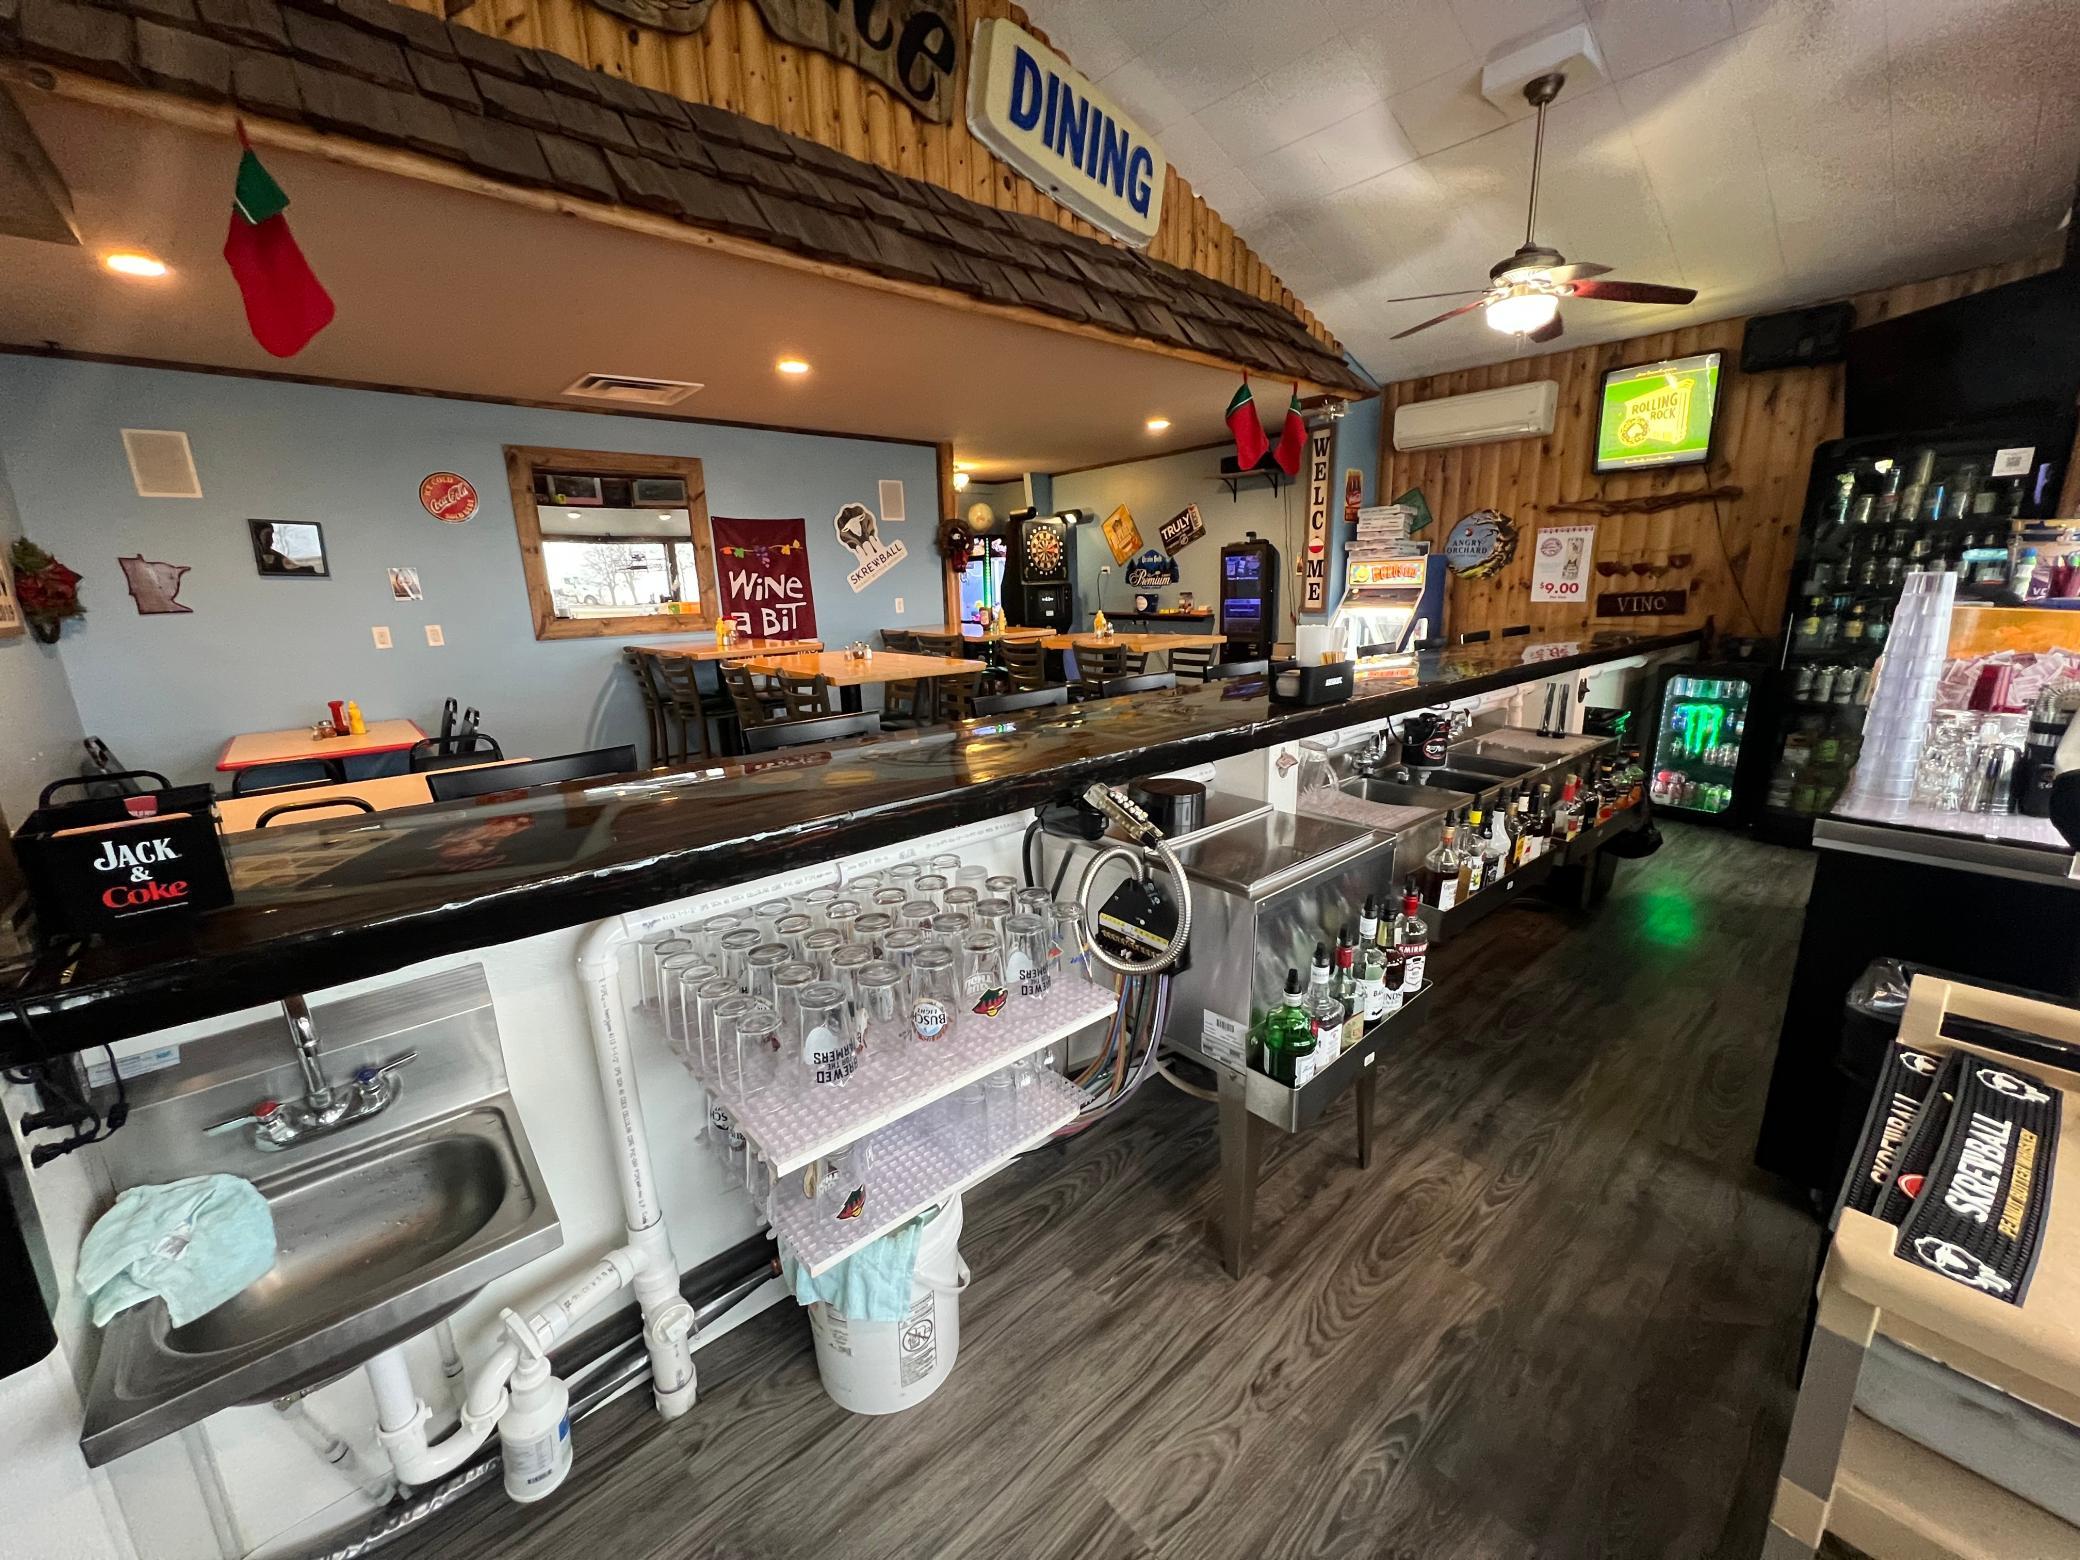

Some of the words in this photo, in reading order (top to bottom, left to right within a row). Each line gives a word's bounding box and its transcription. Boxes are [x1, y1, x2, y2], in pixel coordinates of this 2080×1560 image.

[1008, 46, 1153, 218] DINING
[1631, 392, 1678, 414] ROLLING
[1650, 407, 1676, 420] ROCK
[1160, 513, 1191, 540] TRULY
[1446, 546, 1488, 554] ORCHARD
[1452, 539, 1483, 547] ANGRY
[850, 543, 903, 586] SKREWBALL
[1128, 568, 1171, 588] Premium
[1540, 582, 1579, 594] $9.00
[94, 837, 178, 871] JACK
[130, 866, 153, 883] &
[102, 880, 189, 908] Coke
[1945, 1112, 2013, 1224] SKREWBALL
[2006, 1164, 2031, 1205] BUTTER
